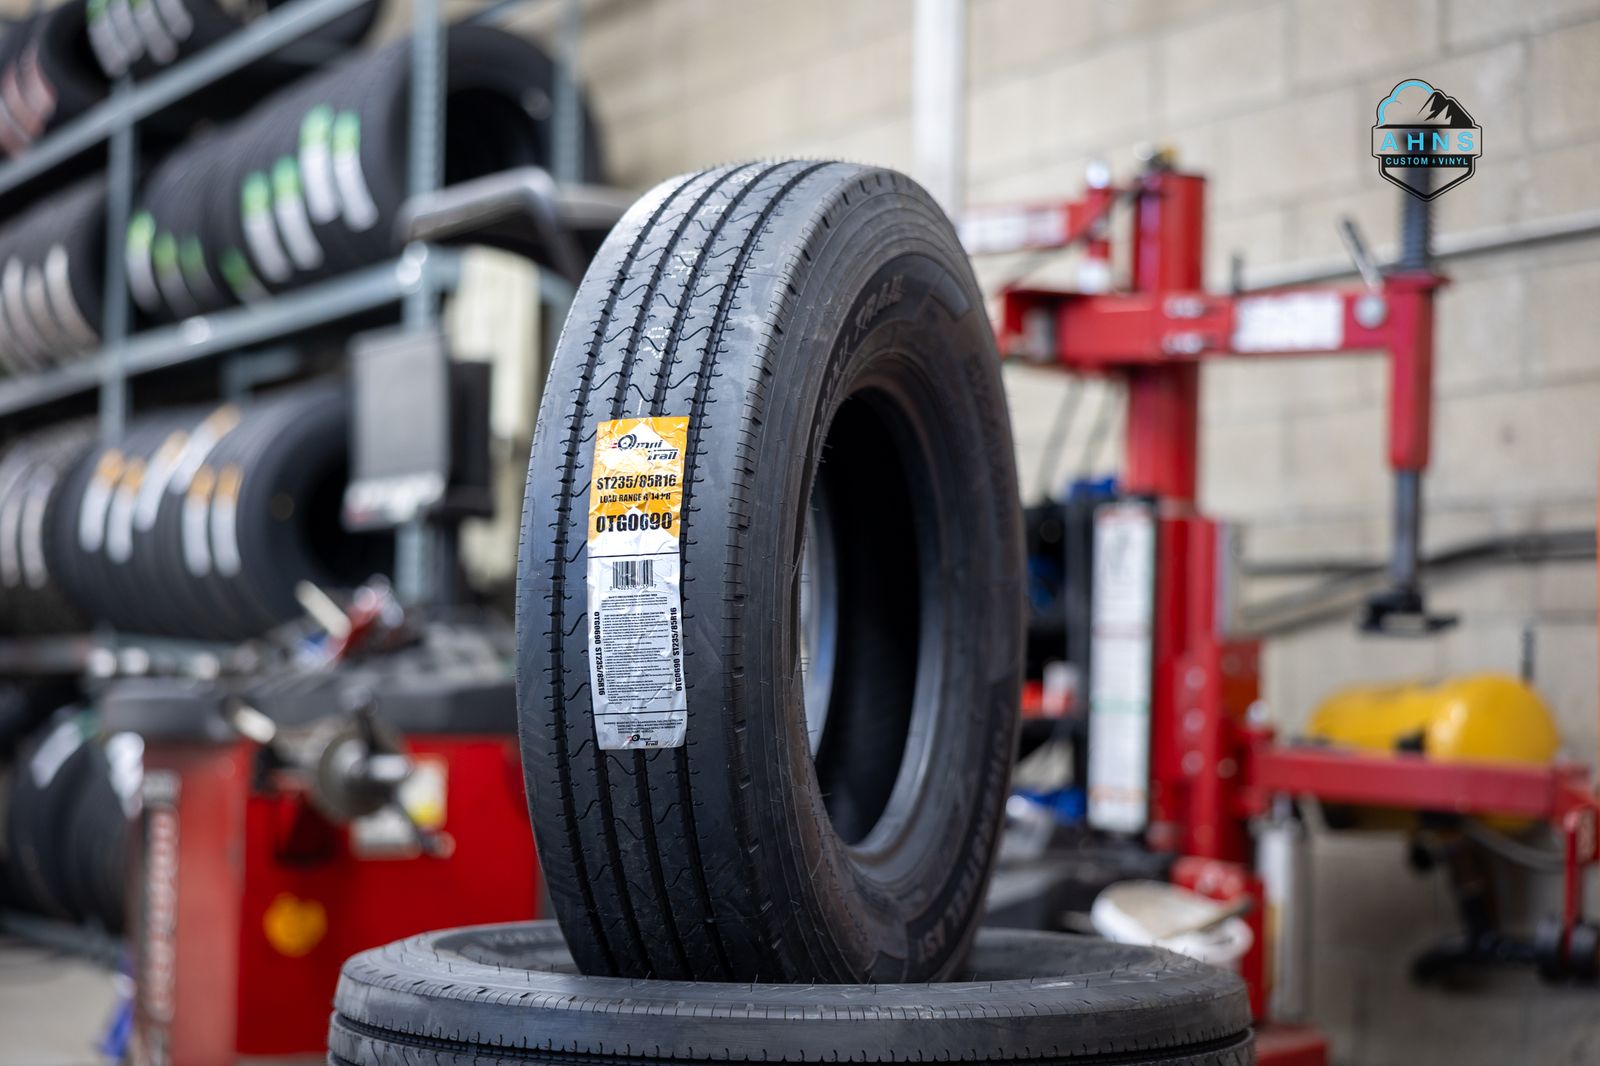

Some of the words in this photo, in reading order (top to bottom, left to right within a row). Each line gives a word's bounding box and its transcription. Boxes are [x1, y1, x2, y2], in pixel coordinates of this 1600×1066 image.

[617, 433, 663, 451] Omni
[597, 474, 677, 490] ST235/85R16
[619, 493, 641, 503] RANGE
[670, 607, 680, 656] ST235/85R16
[595, 647, 605, 696] ST235/85R16
